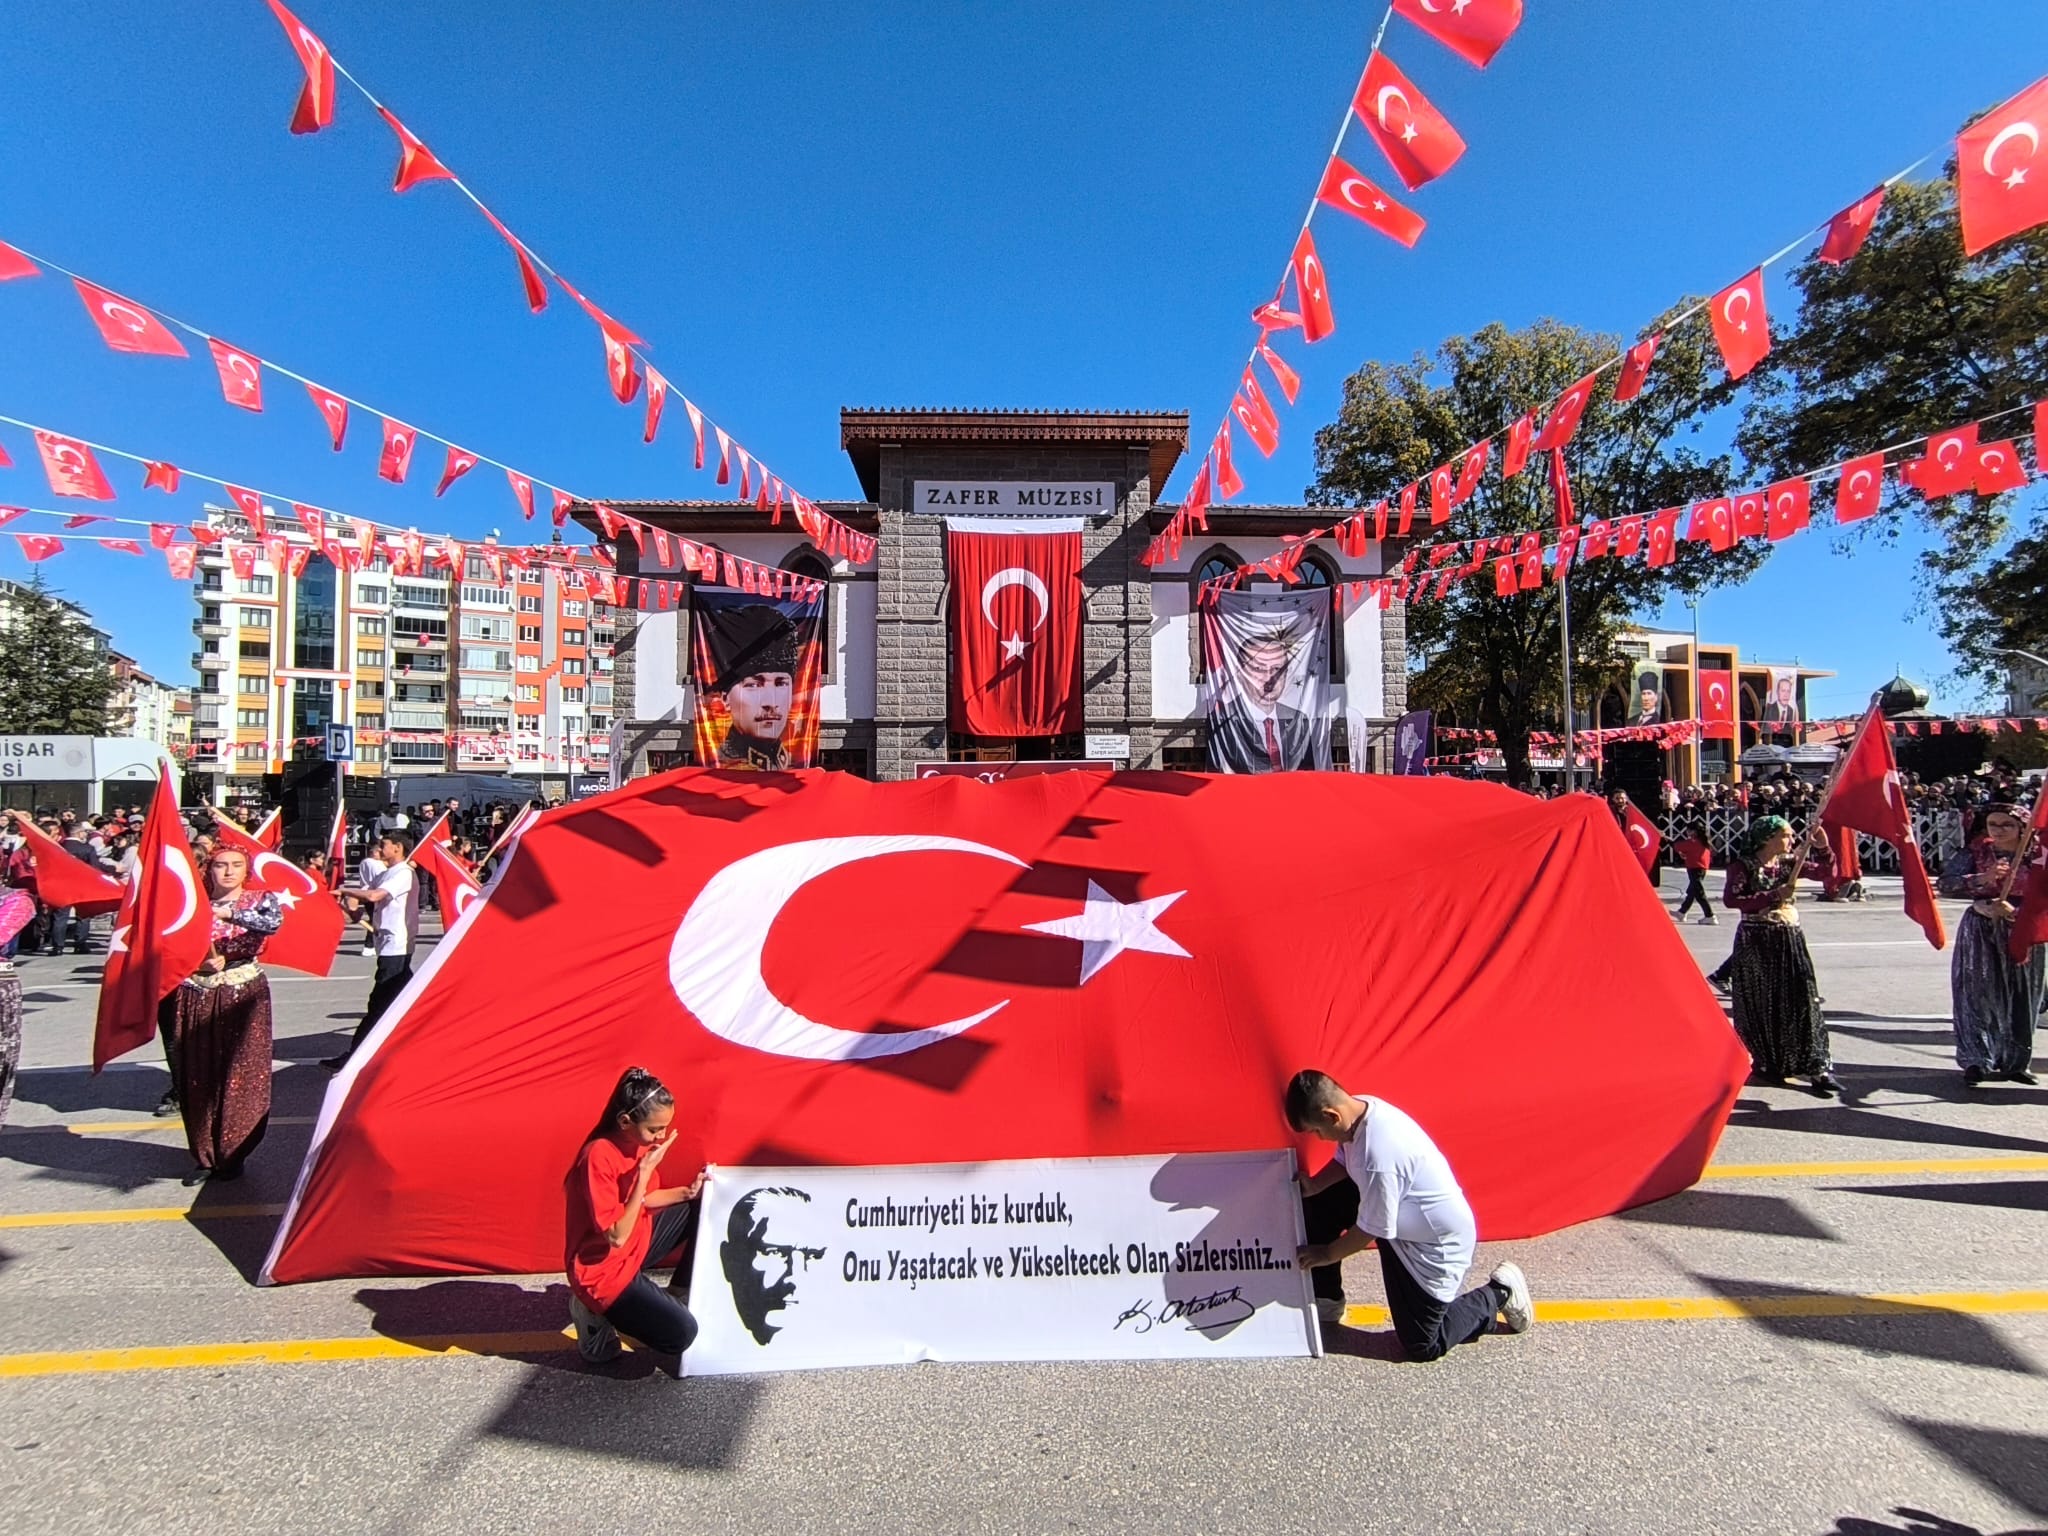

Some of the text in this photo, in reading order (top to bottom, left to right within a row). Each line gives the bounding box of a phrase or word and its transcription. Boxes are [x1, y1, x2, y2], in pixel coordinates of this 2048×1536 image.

[927, 488, 1103, 506] ZAFER MÜZESİ
[0, 739, 55, 757] İSAR
[334, 732, 346, 752] D
[846, 1192, 1073, 1233] Cumhurriyeti biz kurduk,
[843, 1238, 1292, 1290] Onu Yaşatacak ve Yükseltecek Olan Sizlersiniz...
